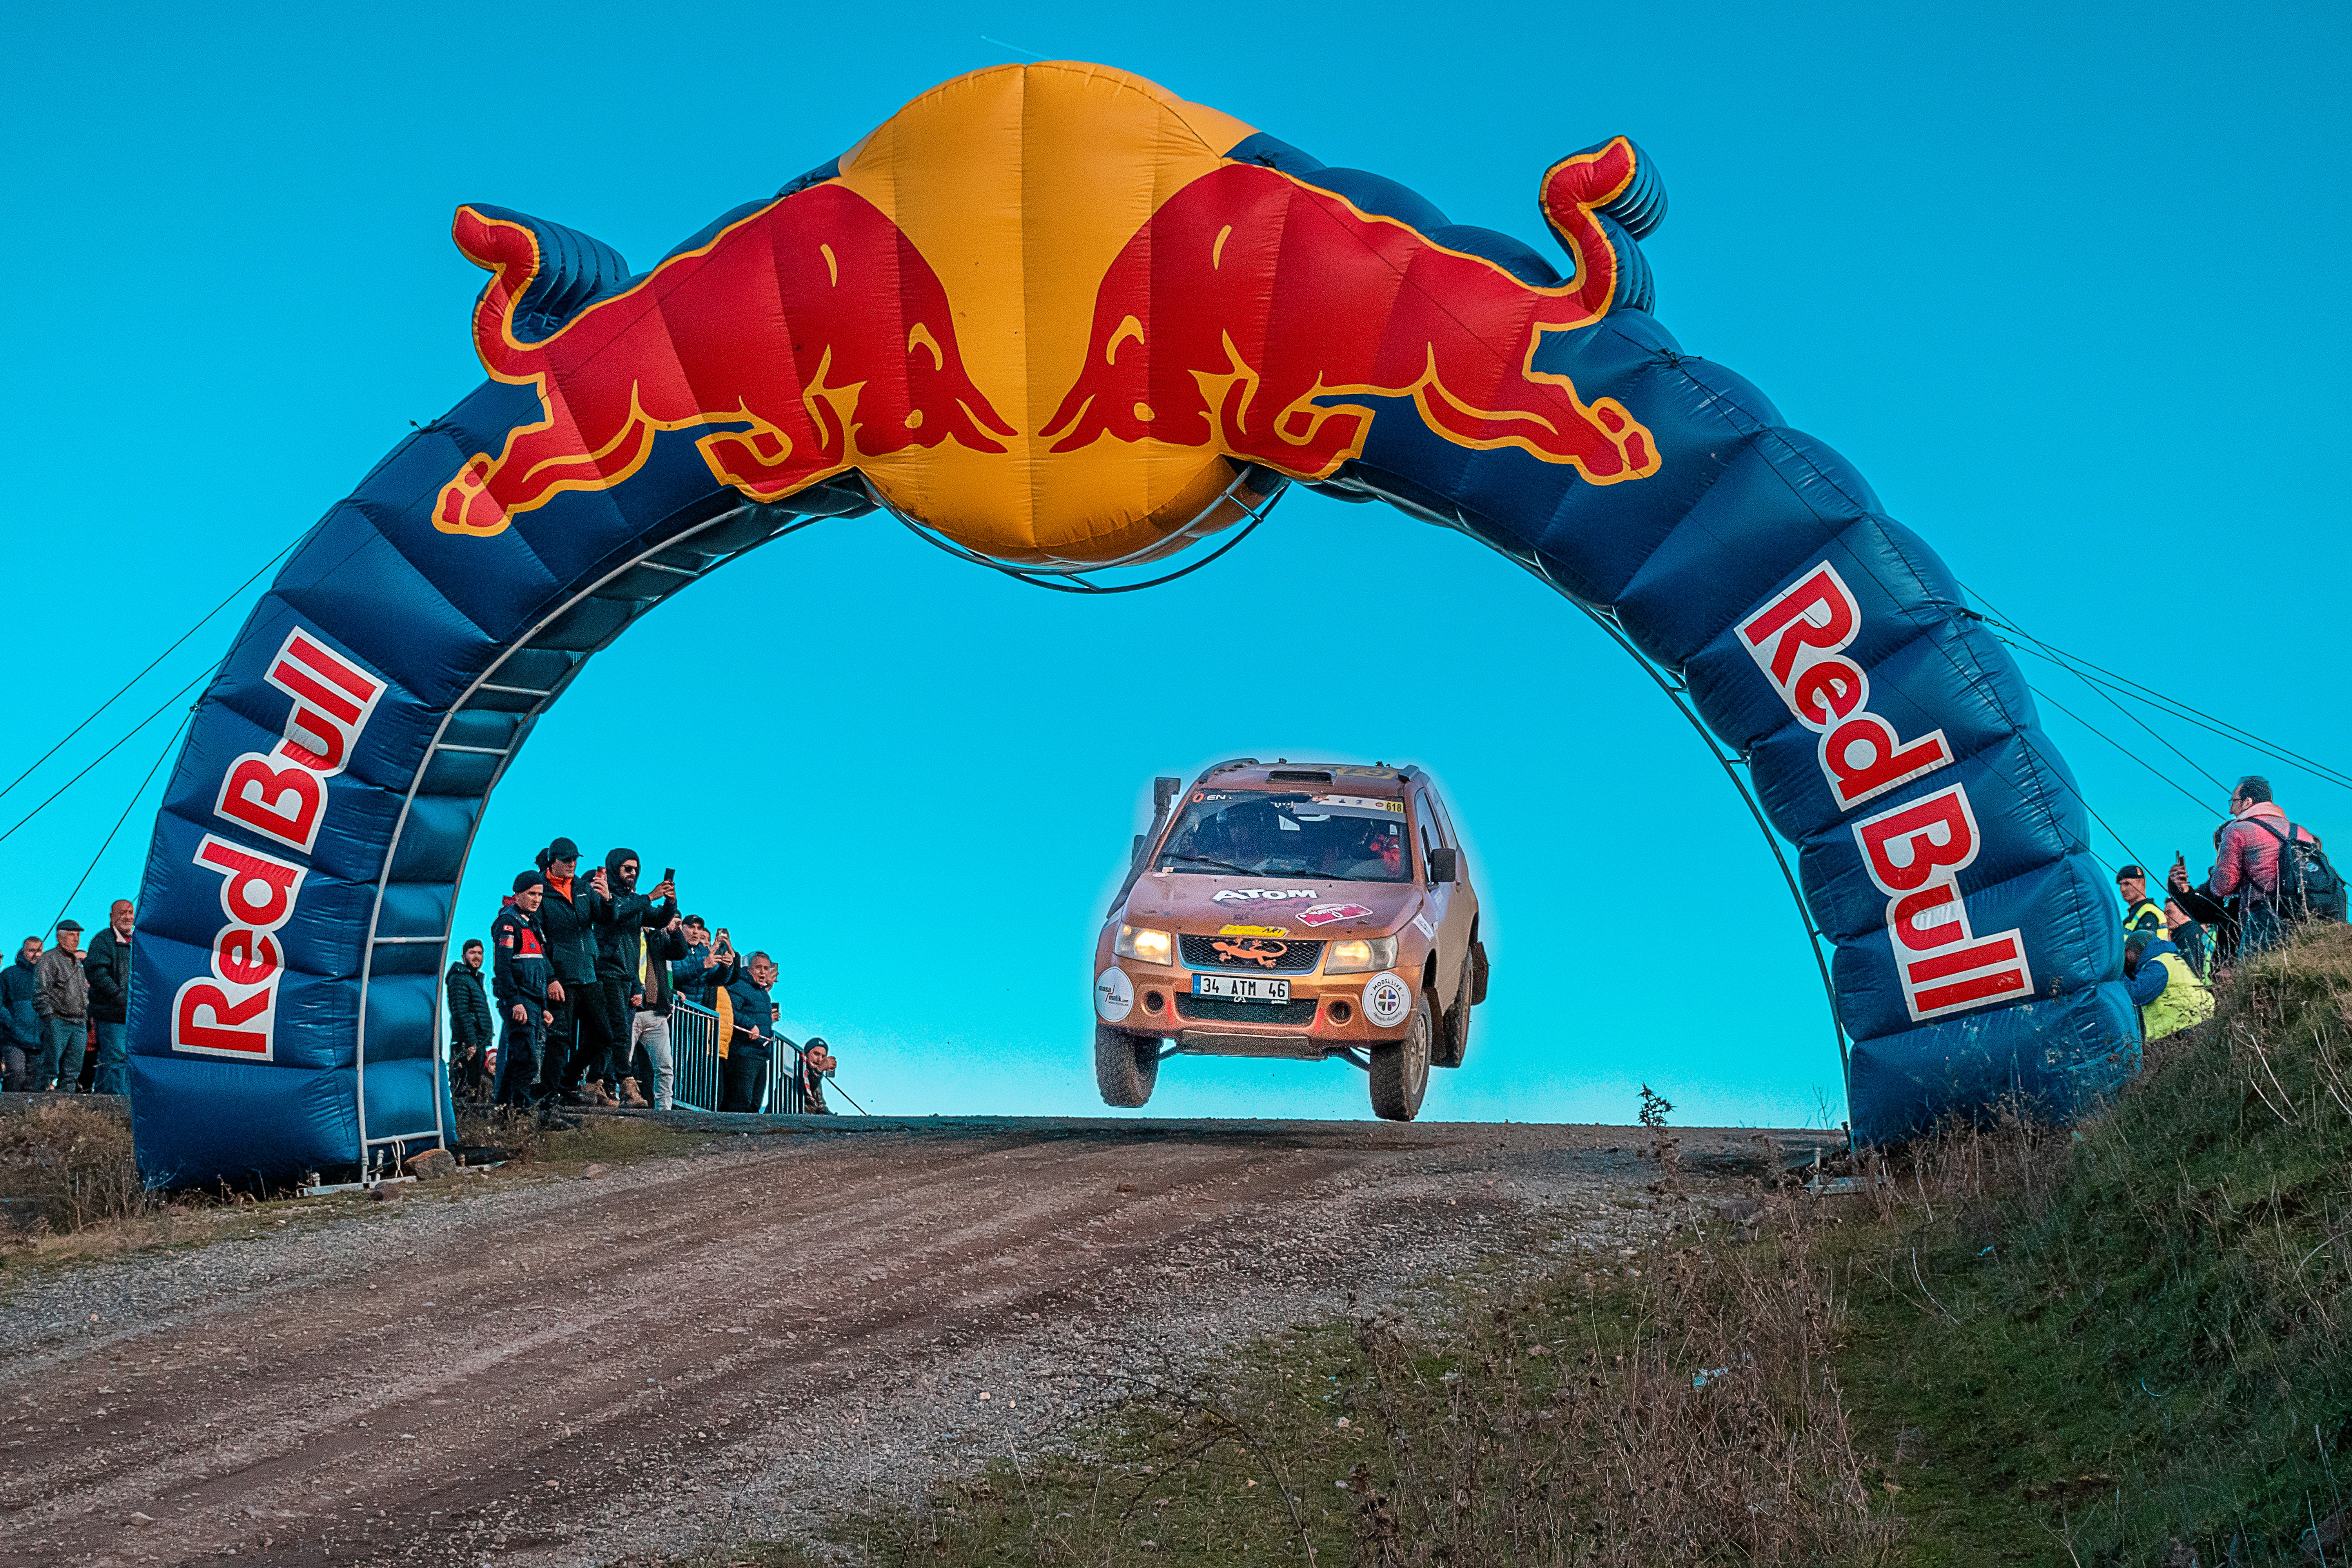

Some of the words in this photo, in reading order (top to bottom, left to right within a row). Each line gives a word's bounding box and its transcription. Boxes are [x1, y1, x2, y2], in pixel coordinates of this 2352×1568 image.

[221, 635, 378, 847] Bull
[1743, 570, 1945, 802] Red
[1860, 791, 2026, 1013] Bull
[1386, 802, 1402, 812] 618
[178, 840, 299, 1054] Red
[1212, 889, 1319, 901] ATOM
[1203, 978, 1219, 993] 34
[1231, 980, 1256, 996] ATM
[1269, 982, 1285, 998] 46
